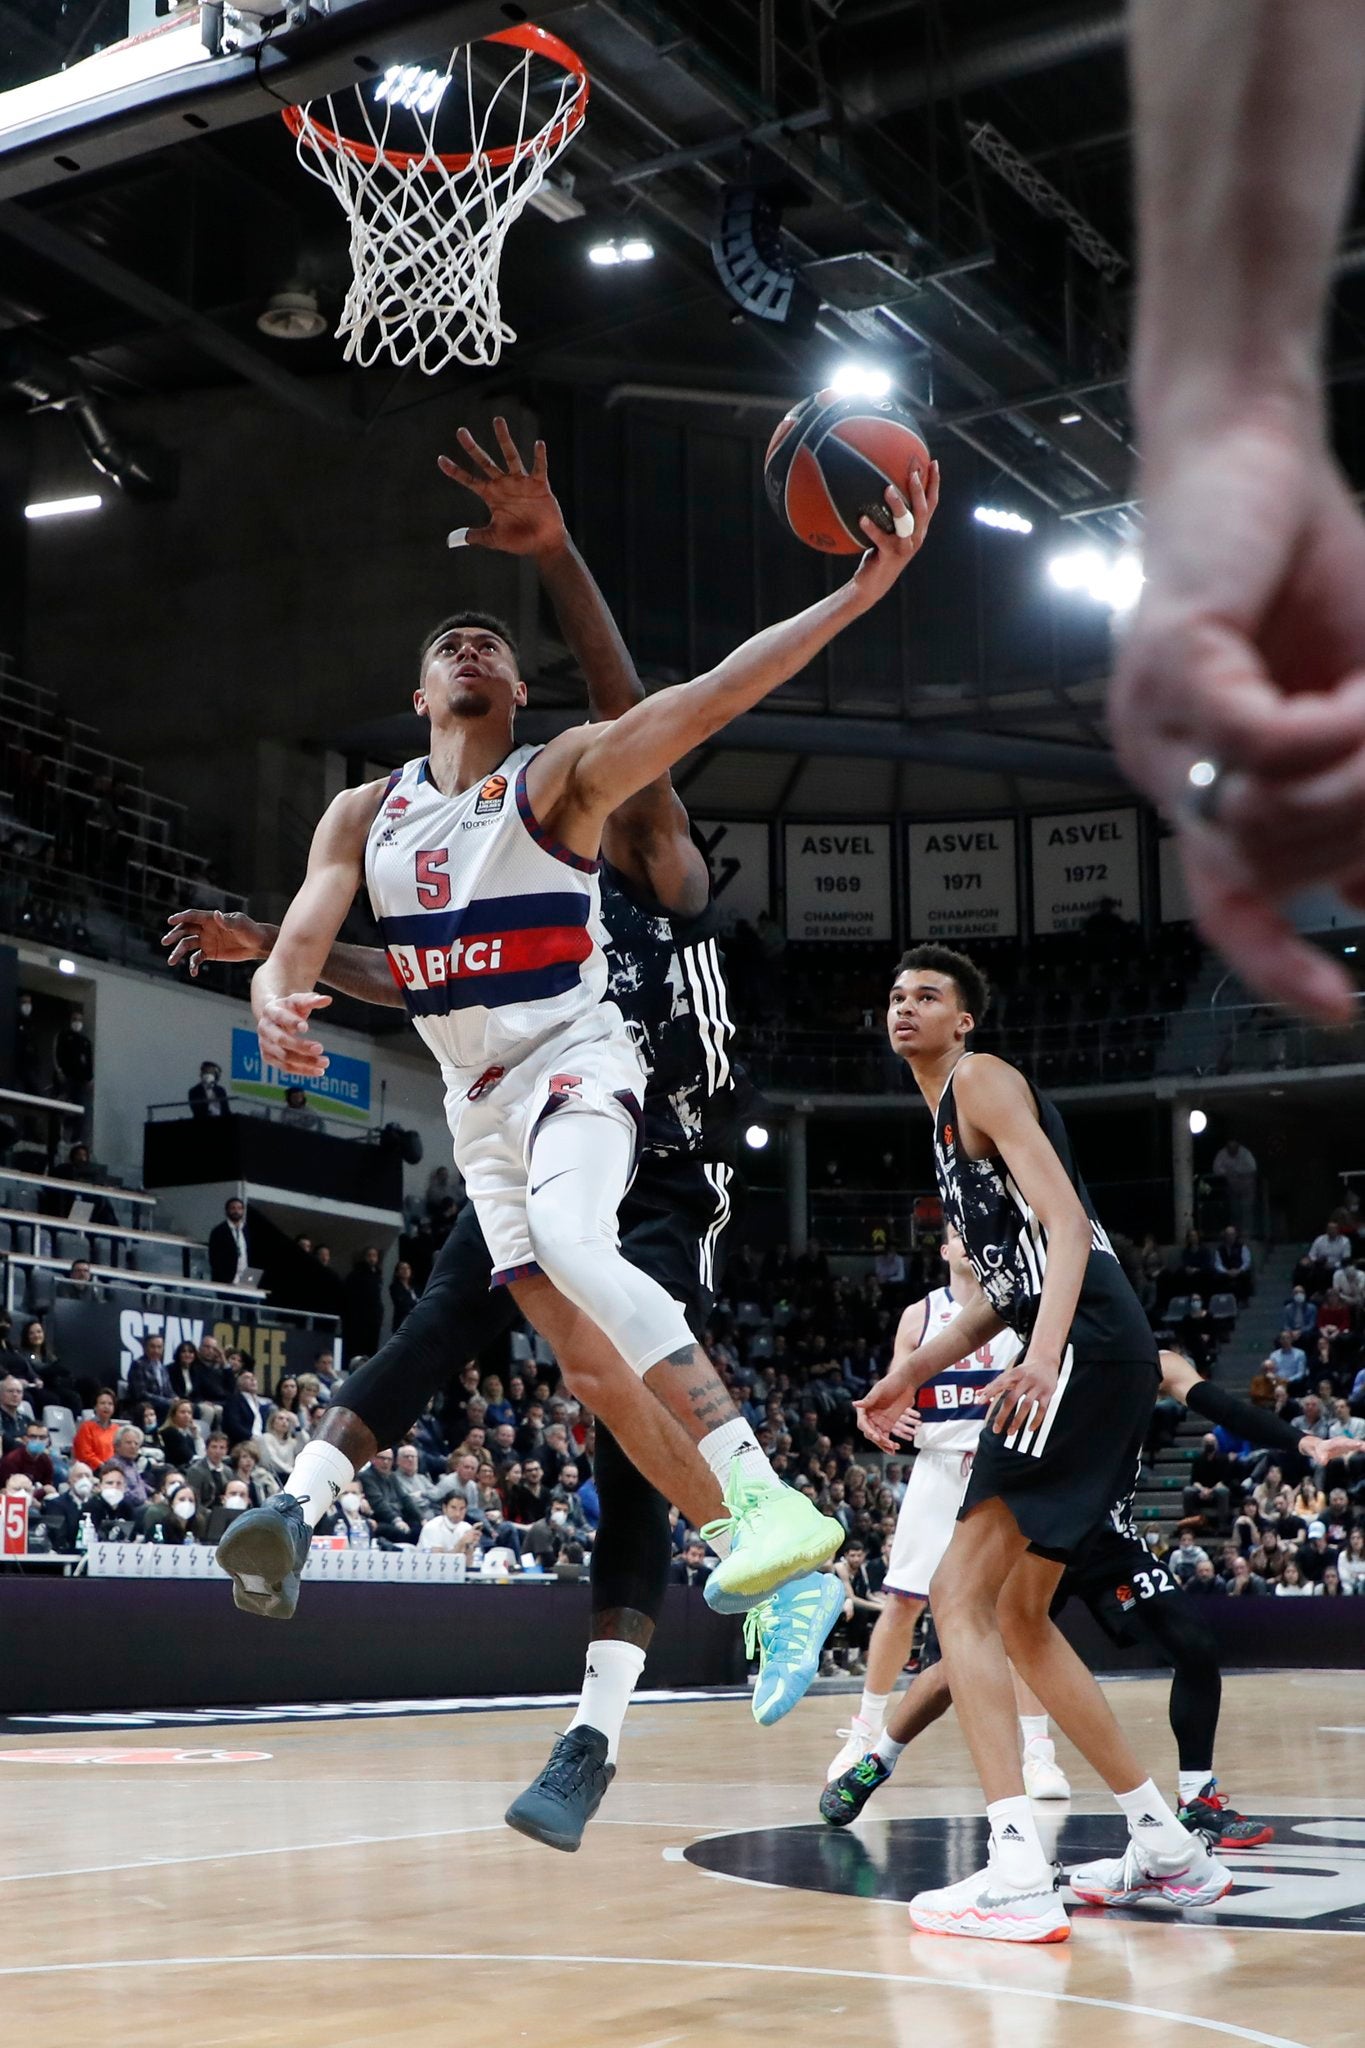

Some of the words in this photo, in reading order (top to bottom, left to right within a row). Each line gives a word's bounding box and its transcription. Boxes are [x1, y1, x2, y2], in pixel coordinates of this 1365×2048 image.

[1048, 822, 1123, 846] ASVEL
[801, 836, 875, 855] ASVEL
[925, 833, 1000, 854] ASVEL
[415, 848, 451, 910] 5
[943, 873, 982, 891] 1971
[1064, 864, 1108, 883] 1972
[815, 876, 862, 893] 1969
[927, 908, 999, 921] CHAMPION
[1052, 897, 1123, 914] CHAMPN
[803, 911, 875, 923] CHAMPION
[804, 926, 819, 937] DE
[822, 926, 874, 937] FRANCE
[929, 924, 945, 936] DE
[947, 923, 999, 935] FRANCE
[6, 1503, 24, 1540] 5
[1133, 1568, 1175, 1599] 32
